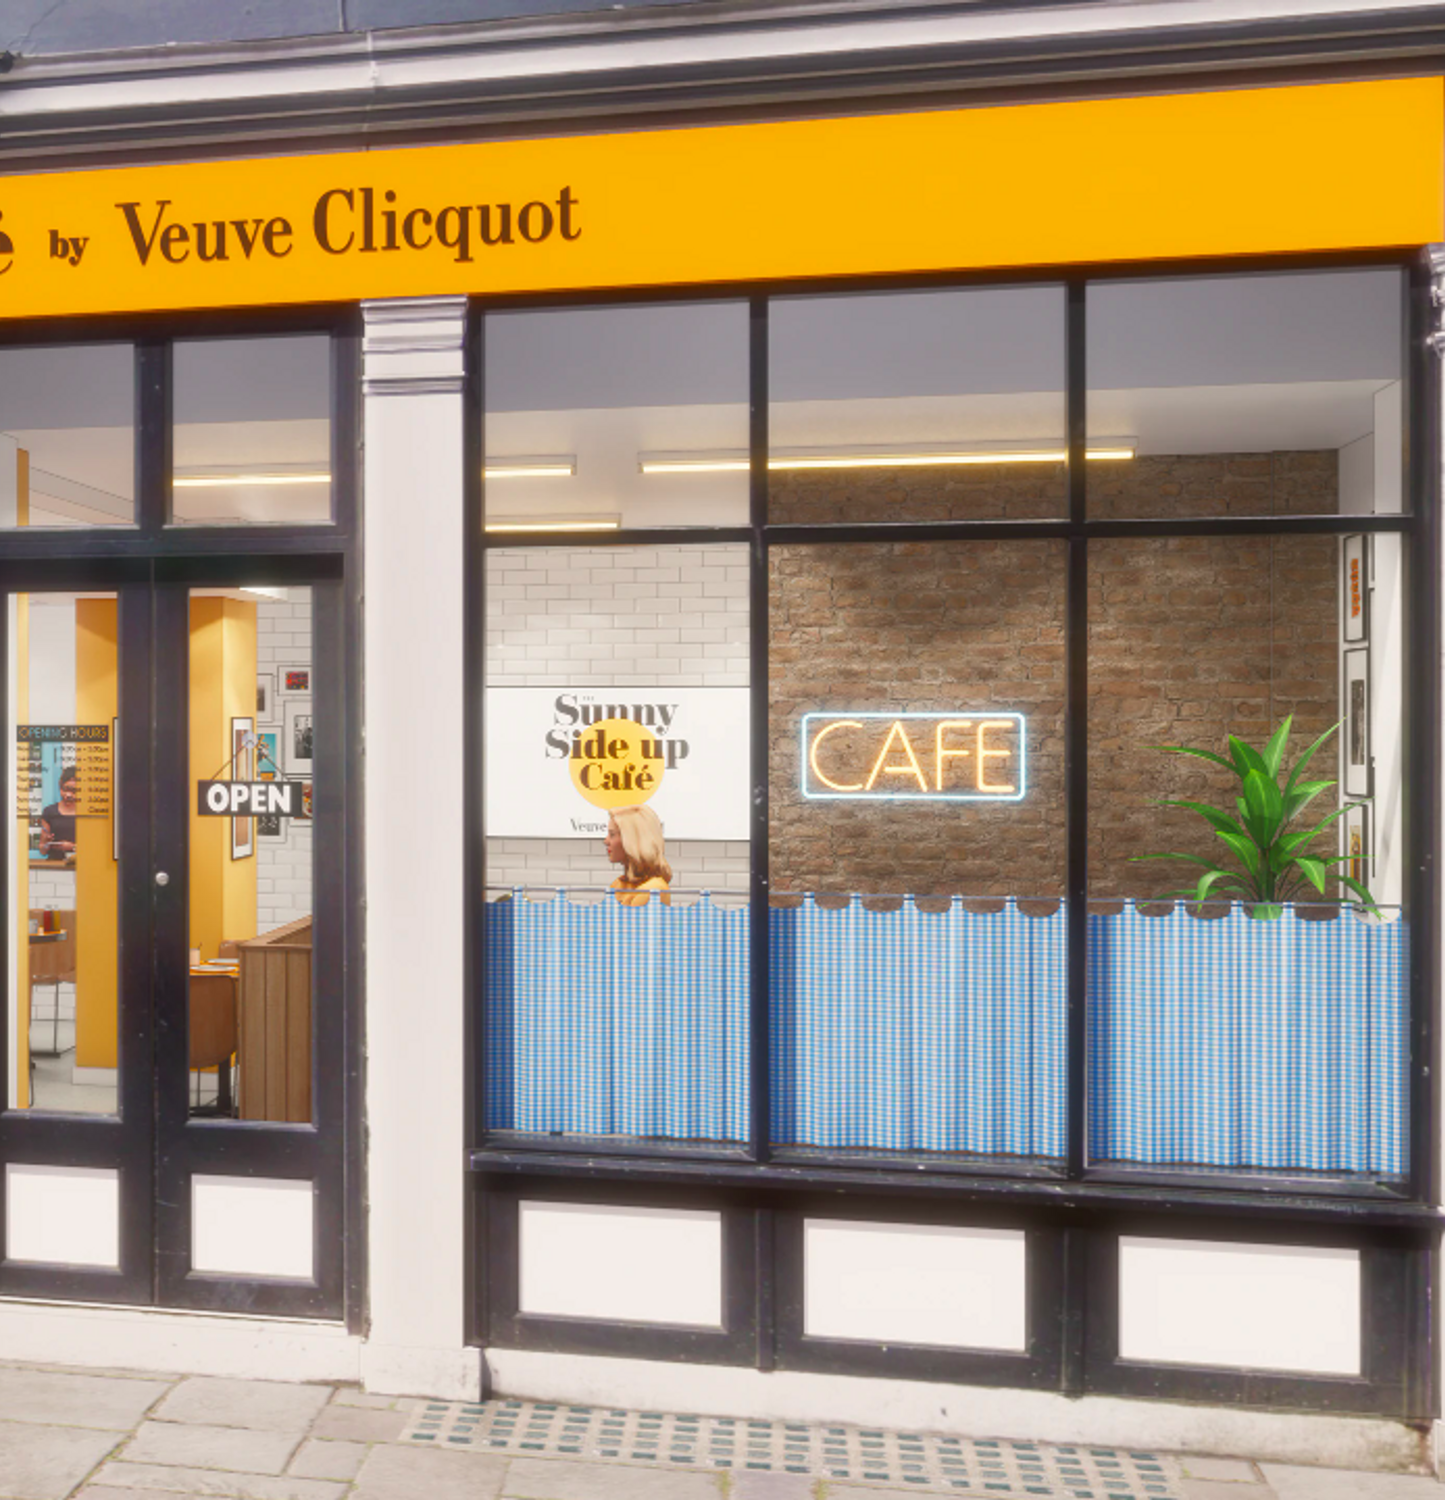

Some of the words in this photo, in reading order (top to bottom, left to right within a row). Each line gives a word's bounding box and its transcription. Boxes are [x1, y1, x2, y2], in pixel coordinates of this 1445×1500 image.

[49, 229, 84, 266] by
[115, 200, 293, 265] Veuve
[313, 186, 581, 262] Clicquot
[18, 726, 68, 739] OPENING
[70, 726, 108, 739] HOURS
[554, 693, 679, 736] Sunny
[545, 728, 630, 760] Side
[640, 738, 690, 770] up
[810, 720, 1016, 793] CAFE
[579, 762, 655, 791] Café
[206, 783, 292, 813] OPEN
[569, 817, 607, 832] Veuve
